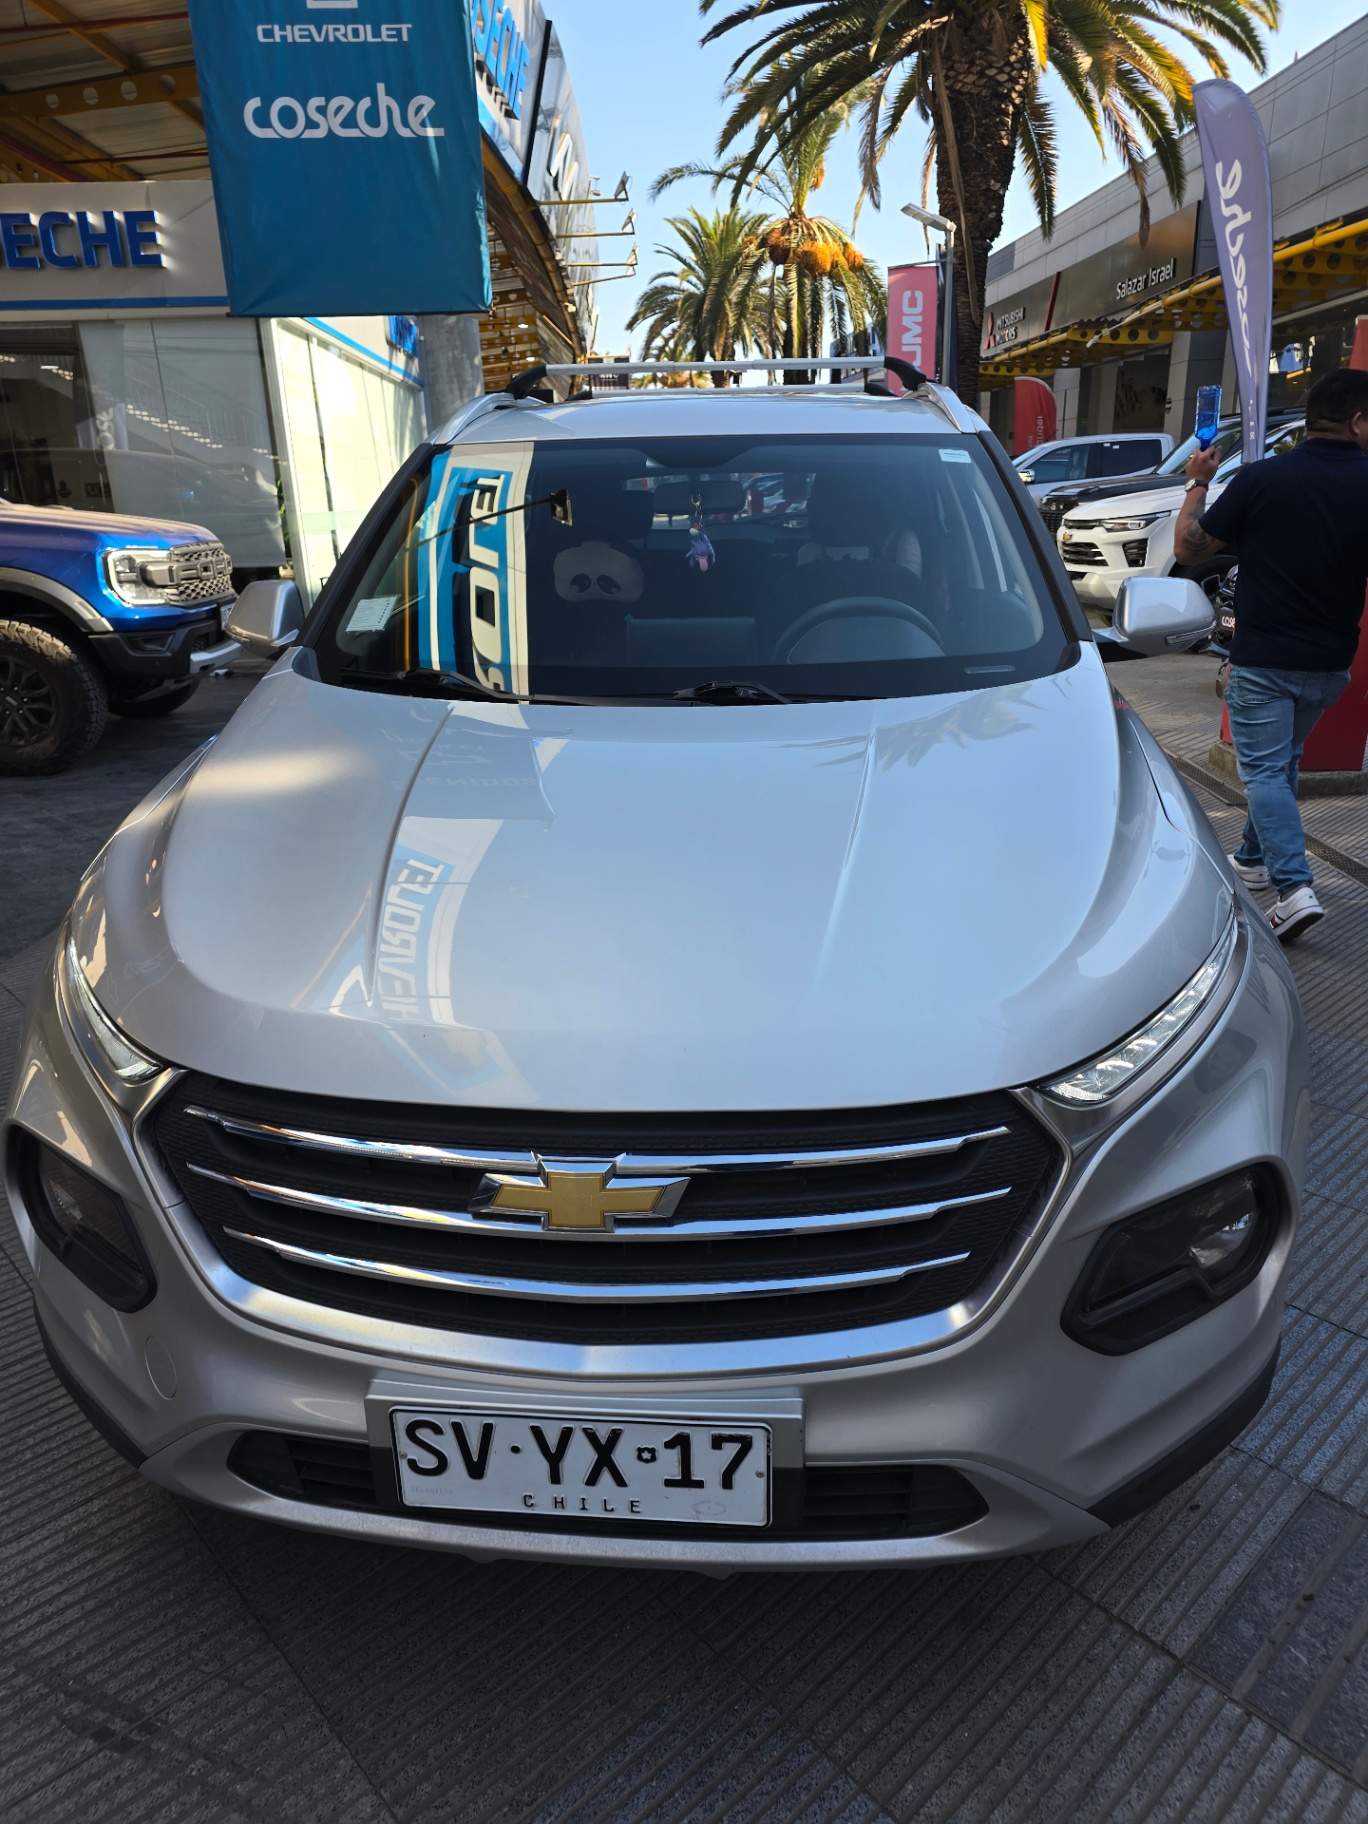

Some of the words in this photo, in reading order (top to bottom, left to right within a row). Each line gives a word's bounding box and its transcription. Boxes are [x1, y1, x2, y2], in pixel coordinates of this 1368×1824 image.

[256, 24, 413, 43] CHEVROLET
[243, 82, 445, 139] coseche
[0, 210, 164, 269] ECHE
[1115, 273, 1147, 300] Salazar
[1148, 256, 1174, 287] Israel
[901, 289, 924, 374] JMC
[523, 1493, 643, 1515] CHILE
